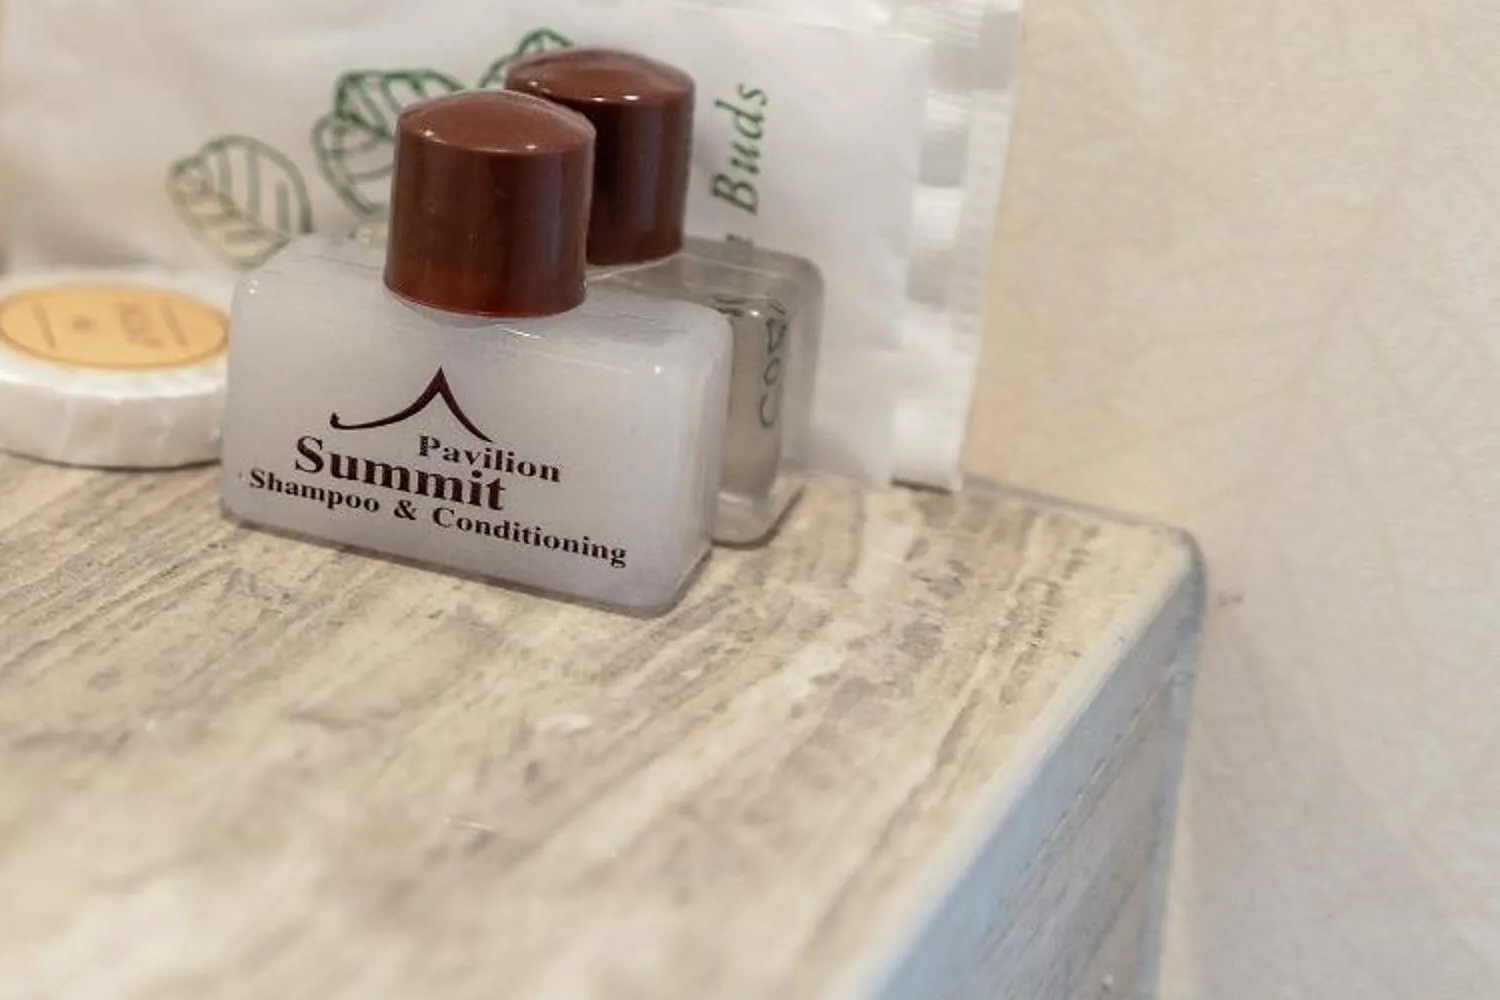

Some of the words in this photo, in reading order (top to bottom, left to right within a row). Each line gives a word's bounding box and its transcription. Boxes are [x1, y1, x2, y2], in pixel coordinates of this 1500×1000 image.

[711, 83, 769, 216] Buds
[294, 435, 506, 511] Summit
[419, 435, 561, 483] Pavilion
[249, 467, 380, 513] Shampoo
[393, 500, 419, 521] &
[433, 506, 629, 569] Conditioning
